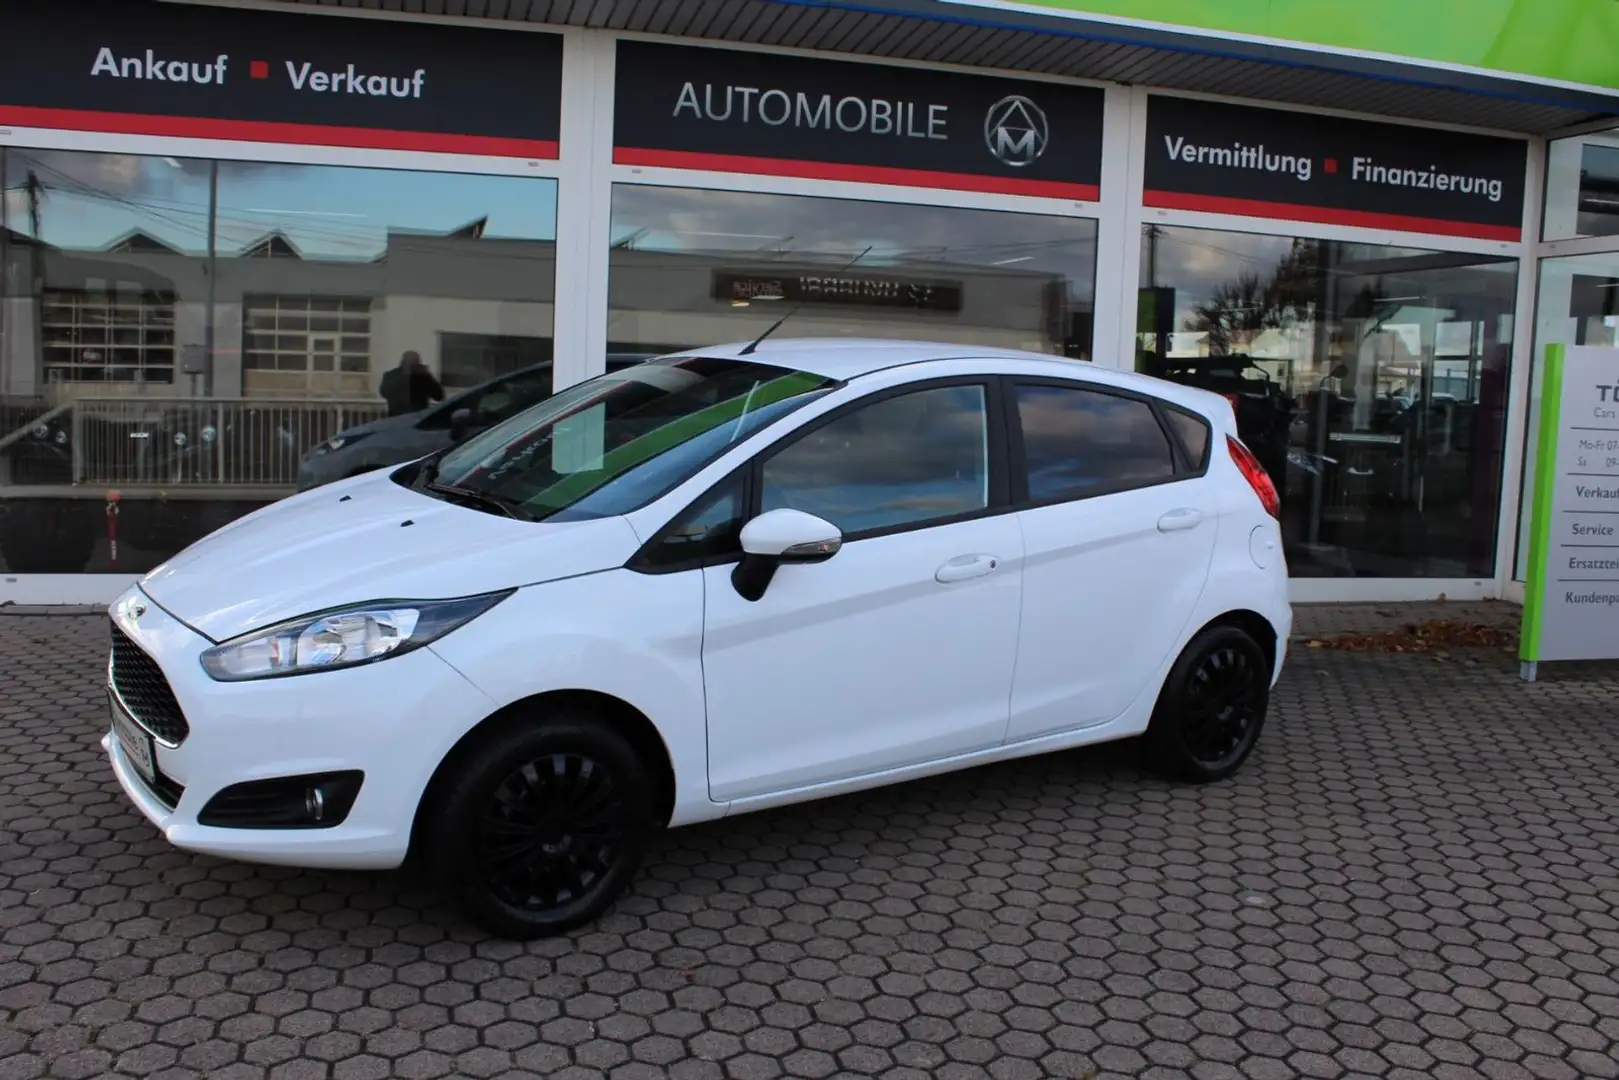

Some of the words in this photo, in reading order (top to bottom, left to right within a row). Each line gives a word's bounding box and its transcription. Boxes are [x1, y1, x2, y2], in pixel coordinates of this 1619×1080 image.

[90, 47, 228, 85] Ankauf
[285, 61, 425, 99] Verkauf
[672, 82, 948, 140] AUTOMOBILE
[1164, 135, 1312, 181] Vermittlung
[1351, 157, 1502, 202] Finanzierung
[1571, 523, 1614, 536] Service
